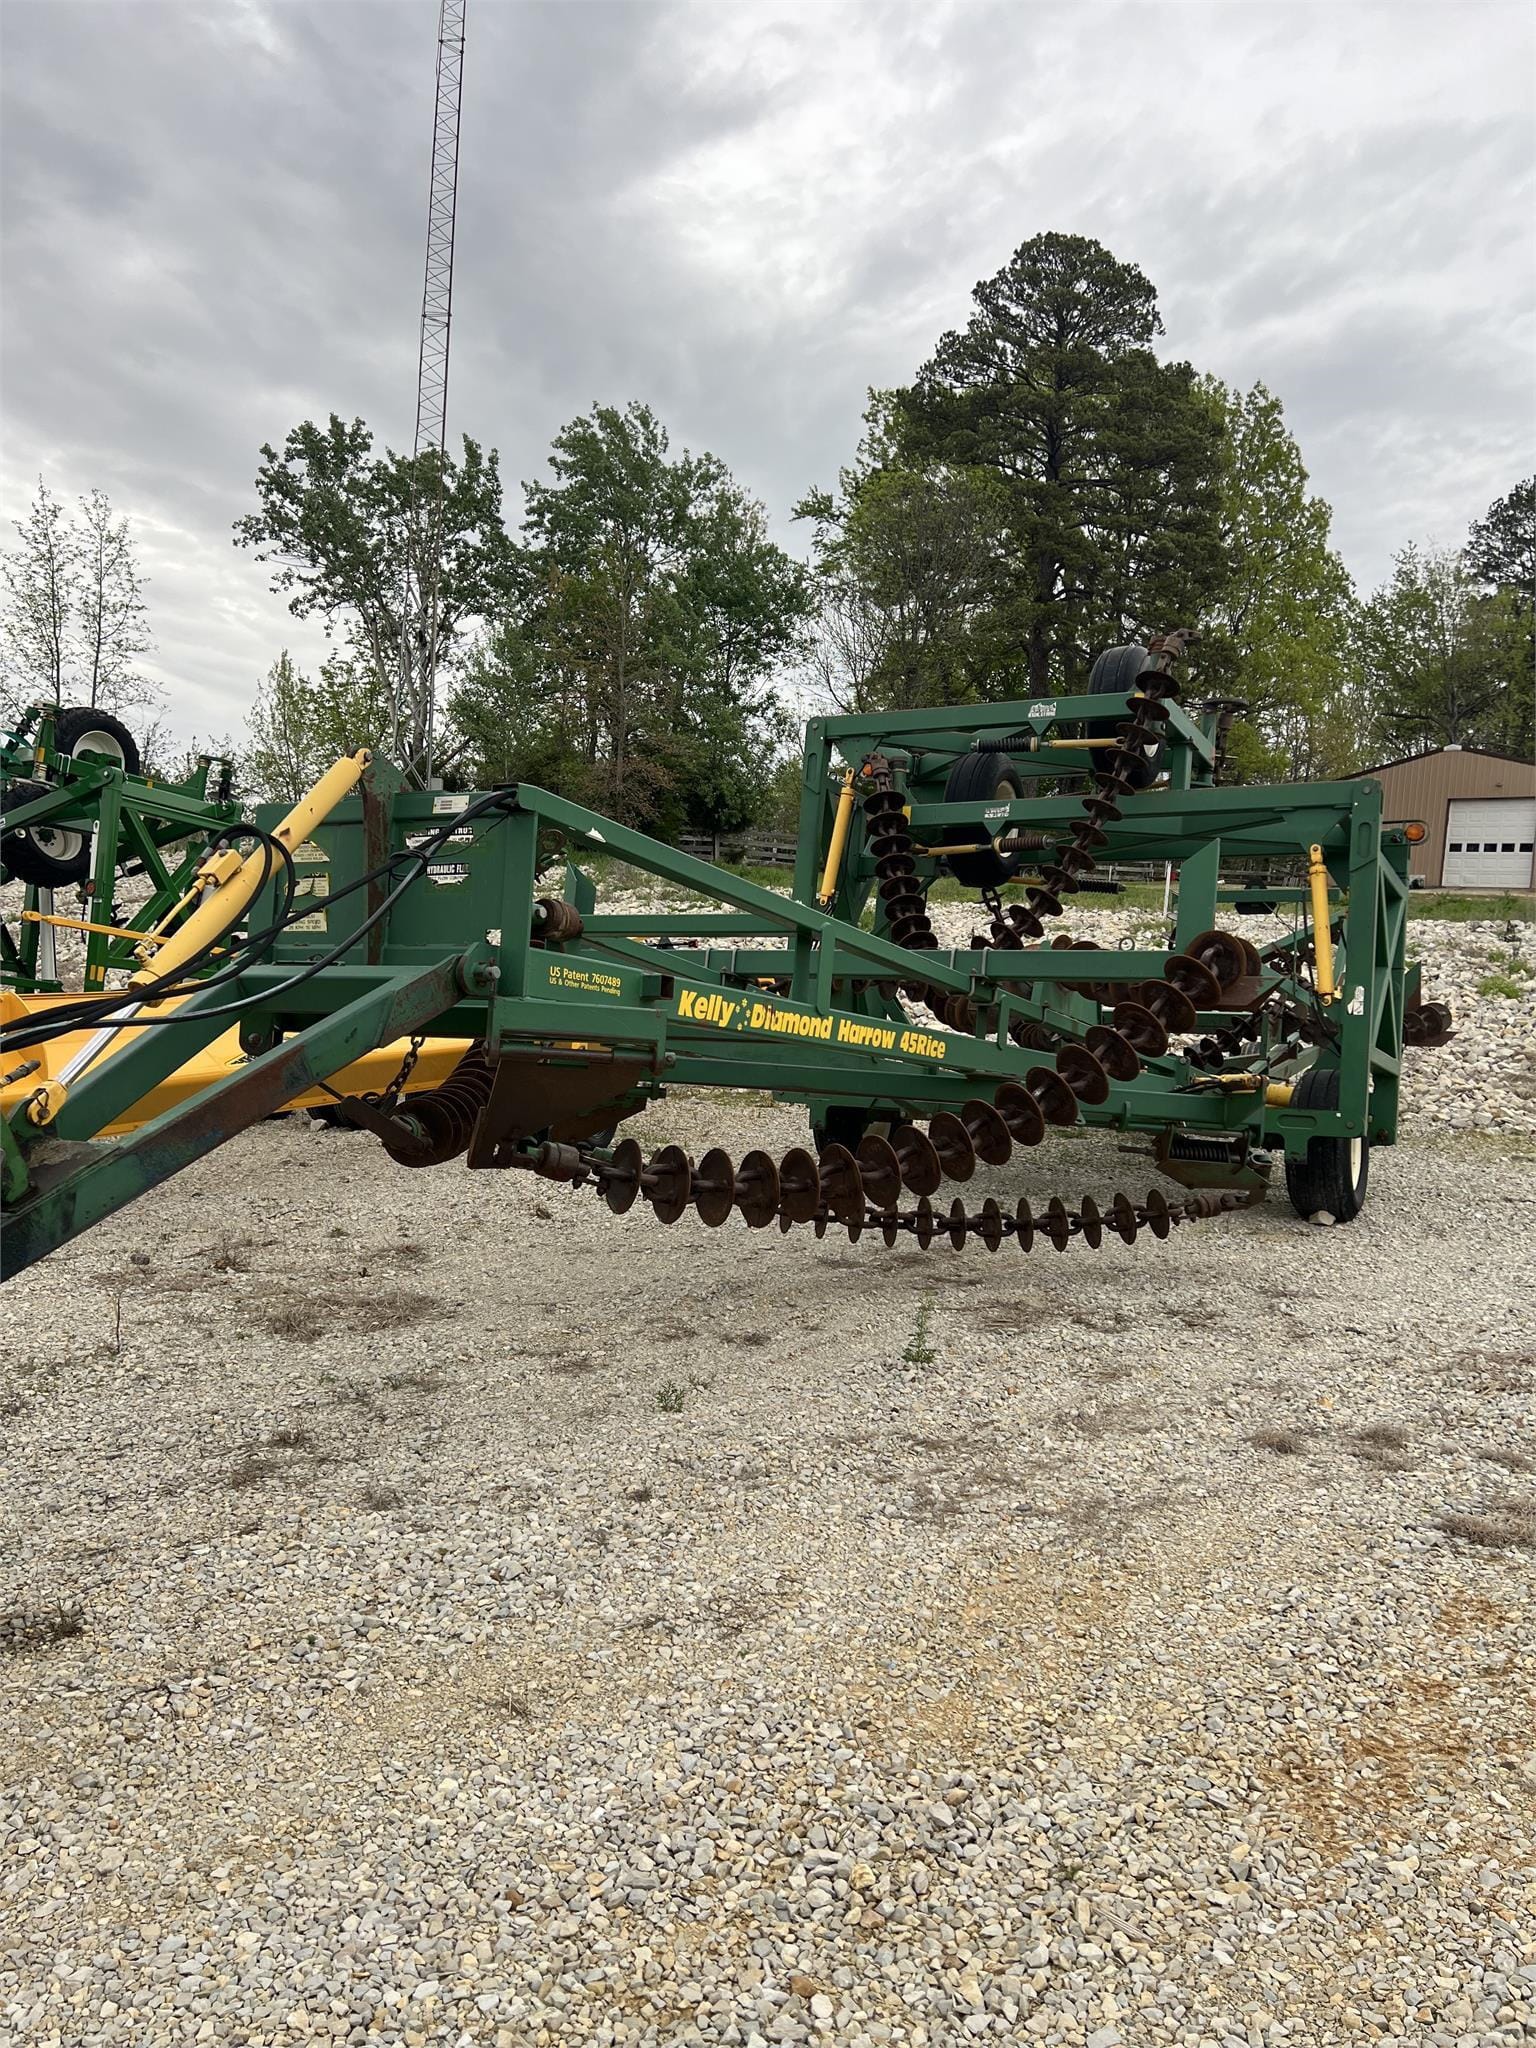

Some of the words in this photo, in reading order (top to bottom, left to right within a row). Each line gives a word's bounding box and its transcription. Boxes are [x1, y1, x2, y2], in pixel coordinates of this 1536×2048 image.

[427, 865, 455, 875] HYDRAULIC
[549, 976, 557, 985] US
[558, 978, 563, 986] &
[564, 979, 580, 988] Other
[580, 982, 600, 992] Patents
[600, 985, 621, 997] Pending
[550, 966, 561, 977] US
[563, 968, 589, 982] Patent
[591, 973, 621, 988] 7607489
[677, 989, 736, 1028] Kelly
[750, 1003, 834, 1040] Diamond
[837, 1019, 896, 1049] Harrow
[900, 1031, 946, 1059] 45Rice
